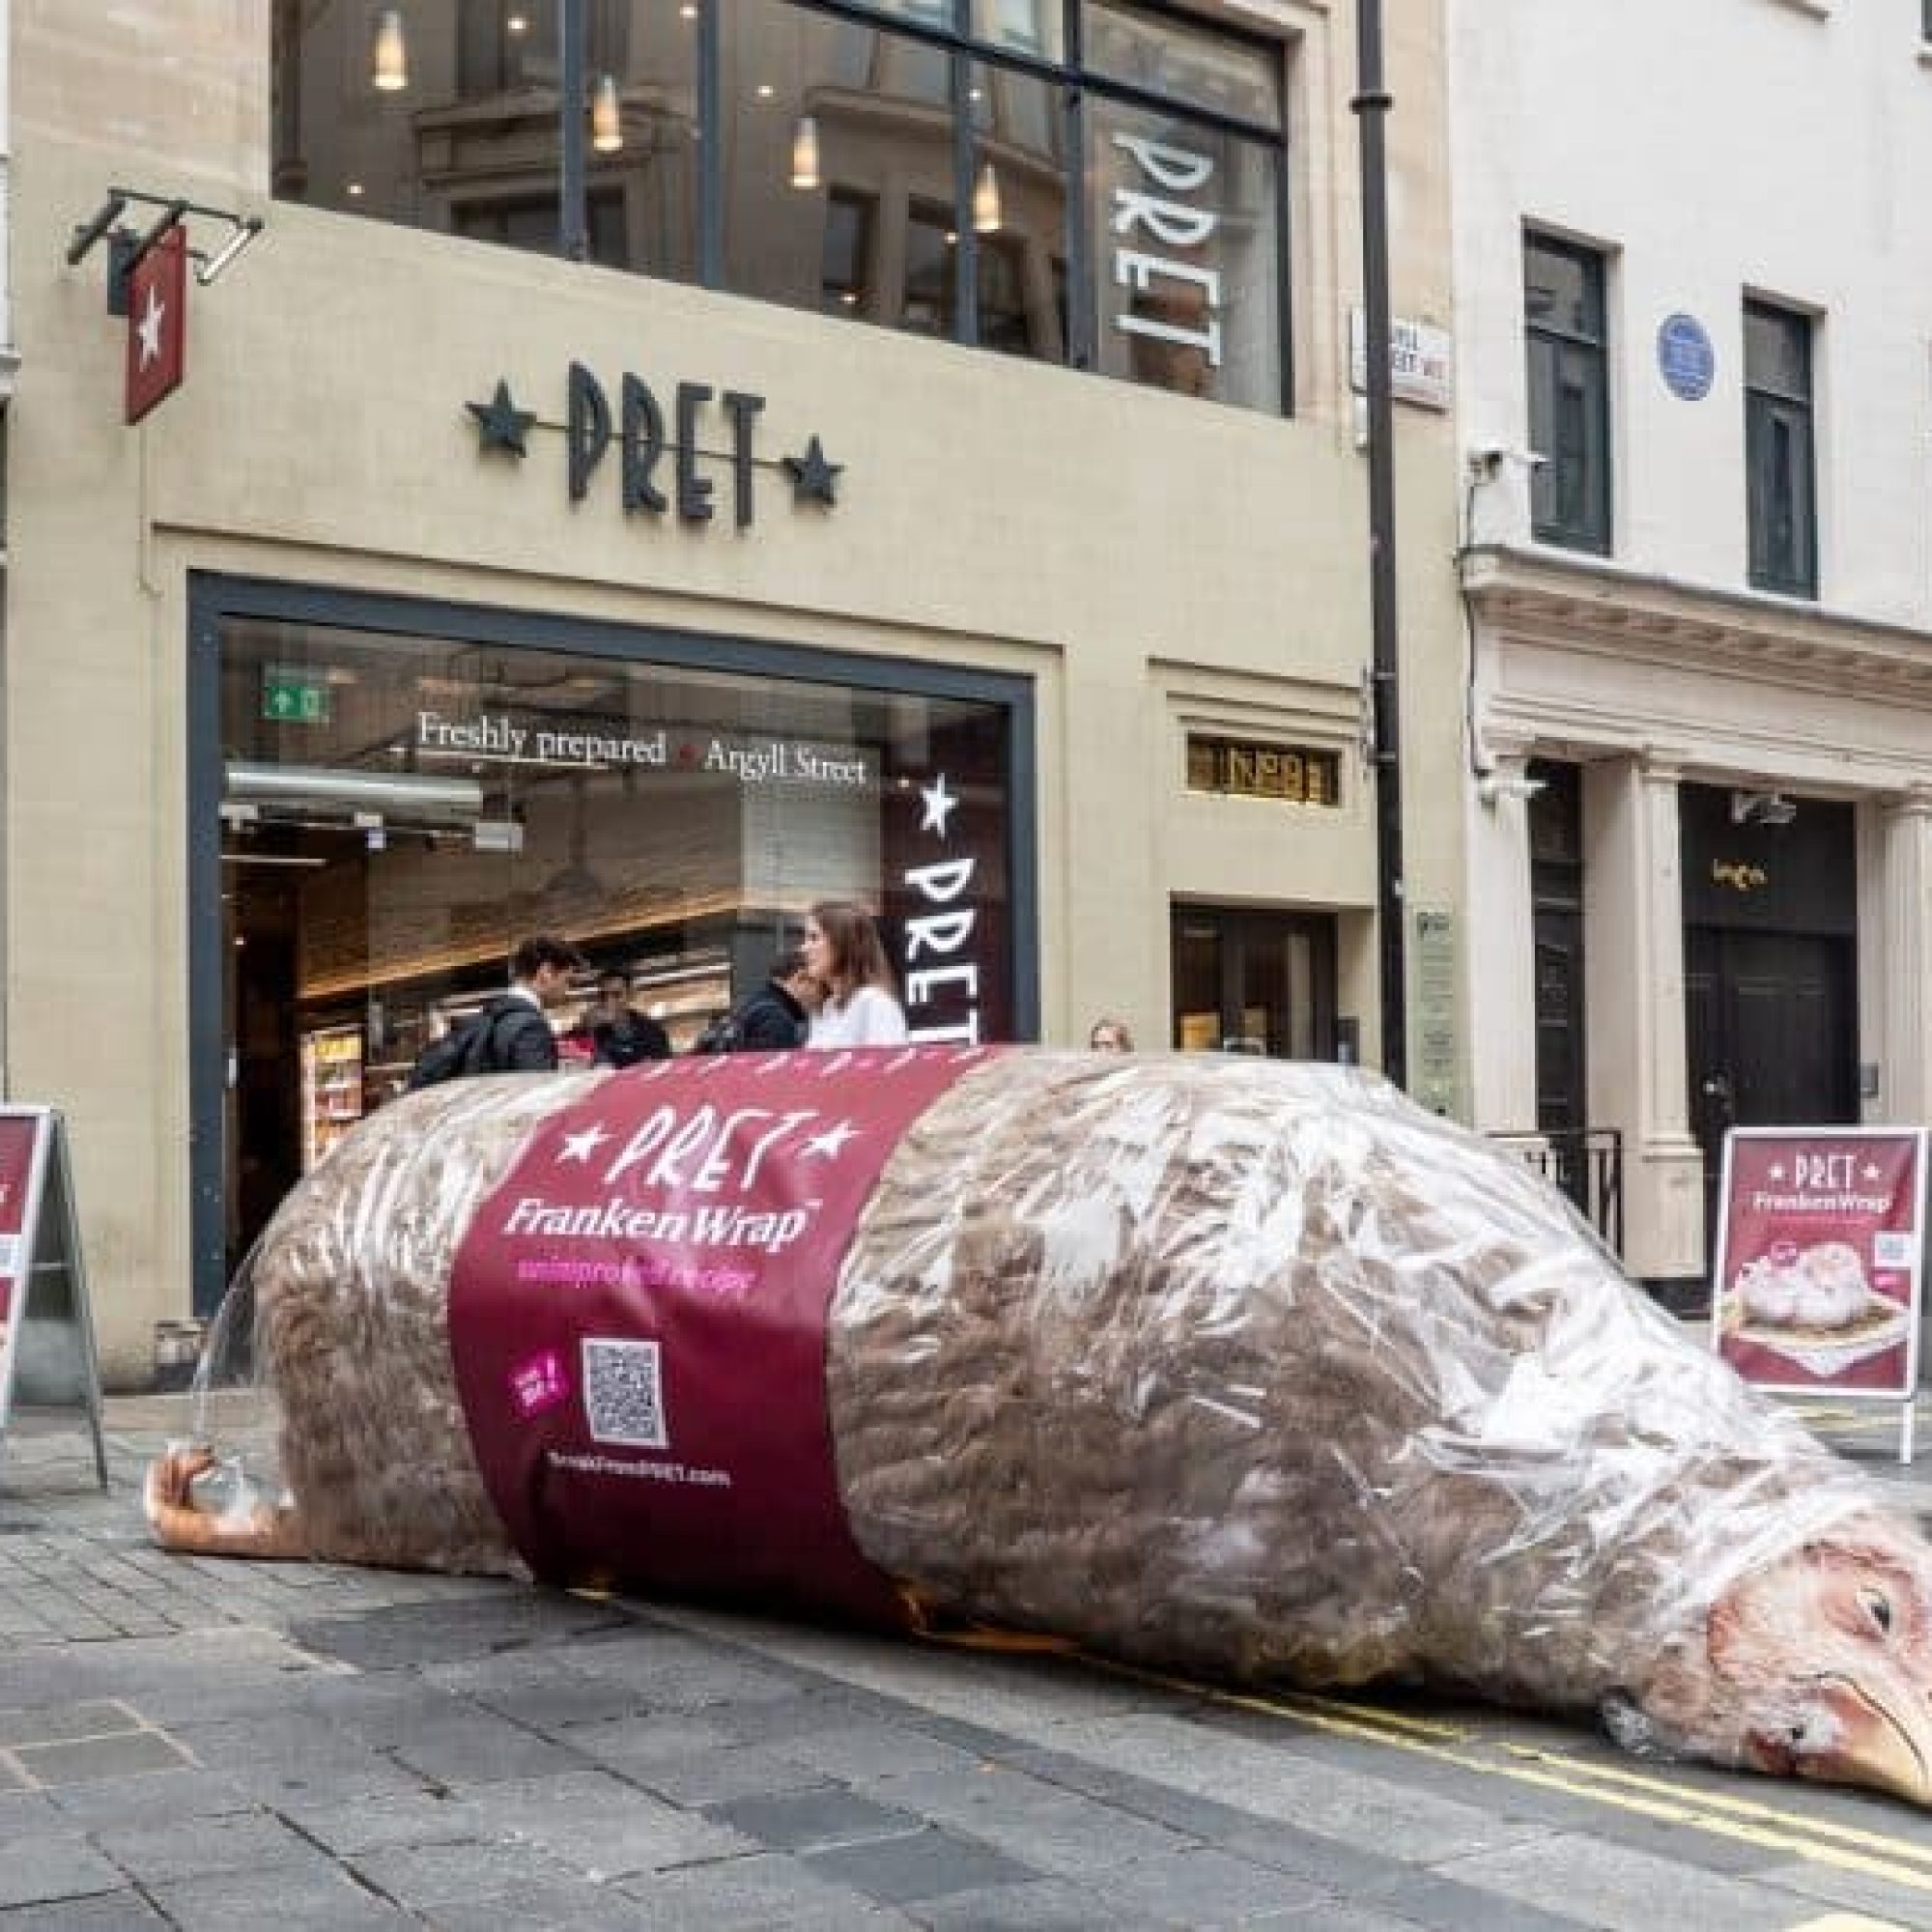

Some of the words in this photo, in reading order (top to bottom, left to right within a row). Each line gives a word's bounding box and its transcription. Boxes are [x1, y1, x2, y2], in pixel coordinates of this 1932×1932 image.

[1112, 132, 1220, 365] PRET
[568, 359, 764, 530] PRET
[418, 711, 526, 760] Freshly
[536, 731, 667, 766] prepared
[703, 739, 784, 783] Argyll
[794, 743, 866, 784] Street
[905, 858, 978, 1046] PRET
[604, 1105, 818, 1191] PRET
[1796, 1152, 1857, 1189] PRET
